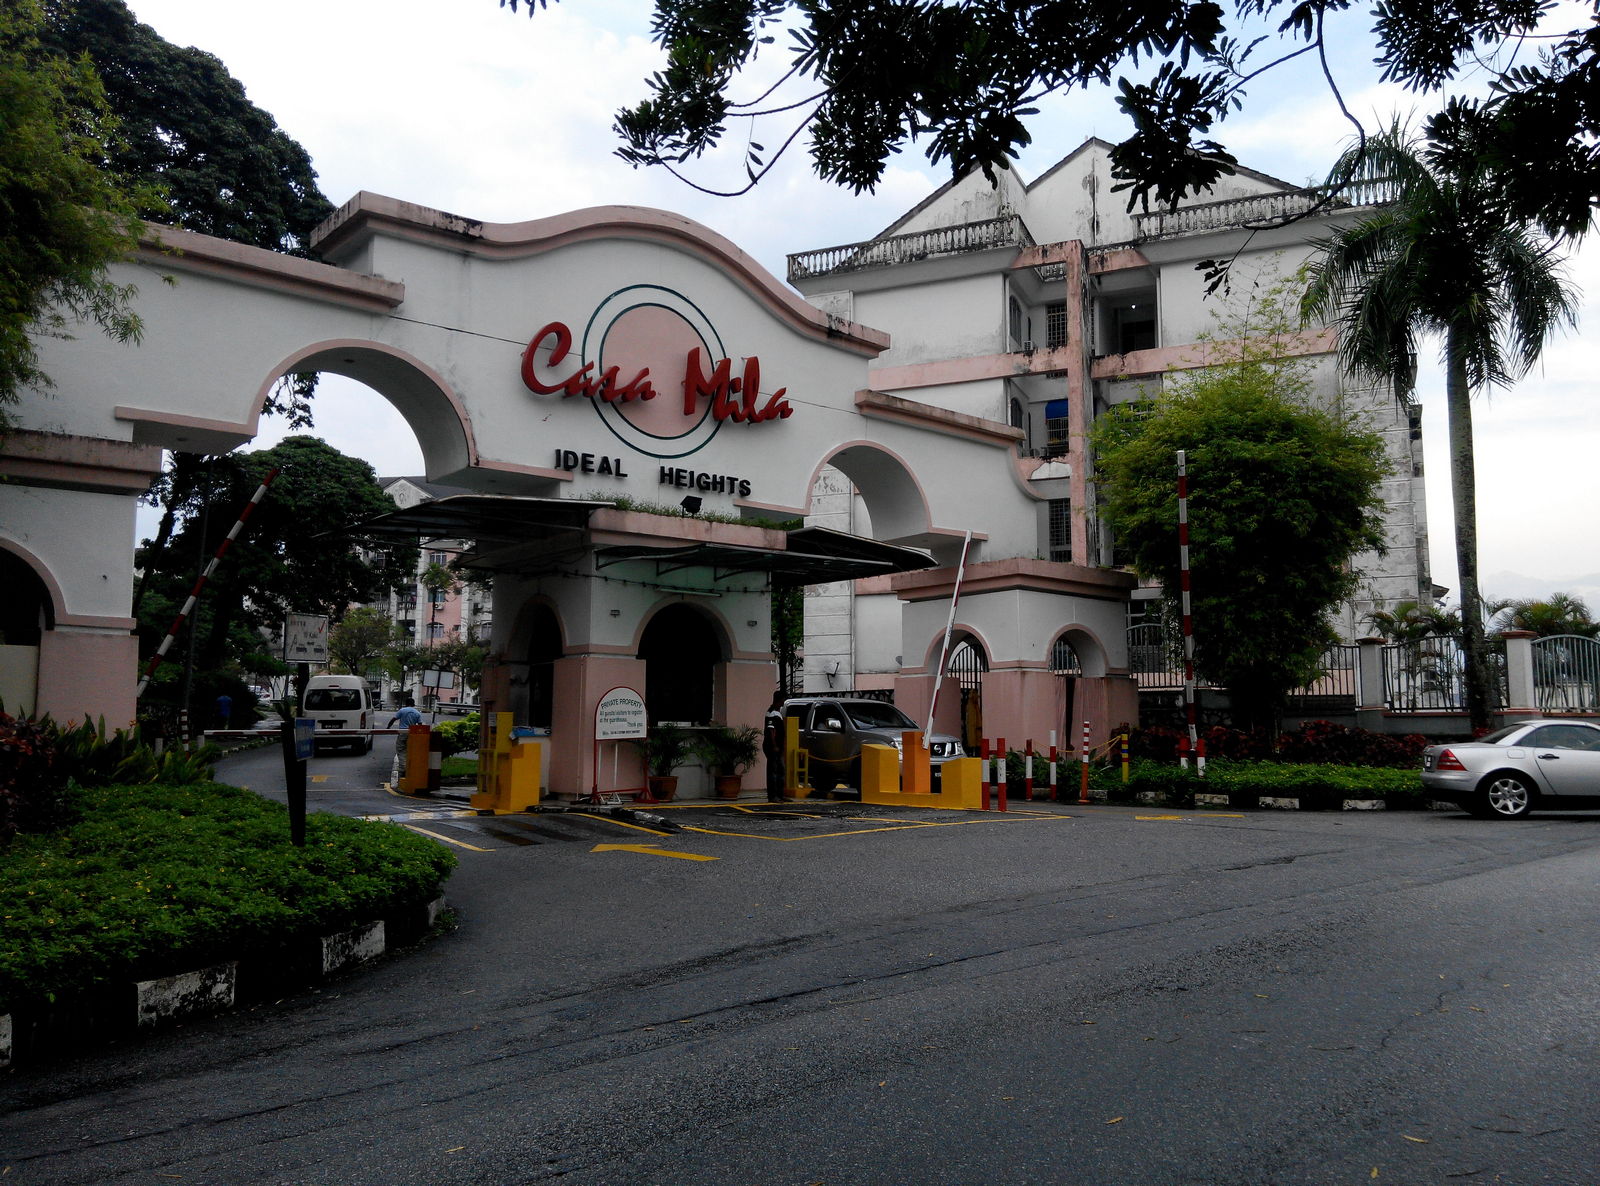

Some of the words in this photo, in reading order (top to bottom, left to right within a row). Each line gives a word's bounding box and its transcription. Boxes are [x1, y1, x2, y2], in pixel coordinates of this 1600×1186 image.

[521, 322, 656, 402] Casa
[684, 346, 793, 424] Mila
[555, 449, 628, 478] IDEAL
[659, 466, 751, 497] HEIGHTS
[601, 699, 618, 709] PRIVATE
[620, 698, 642, 708] PROPERTY
